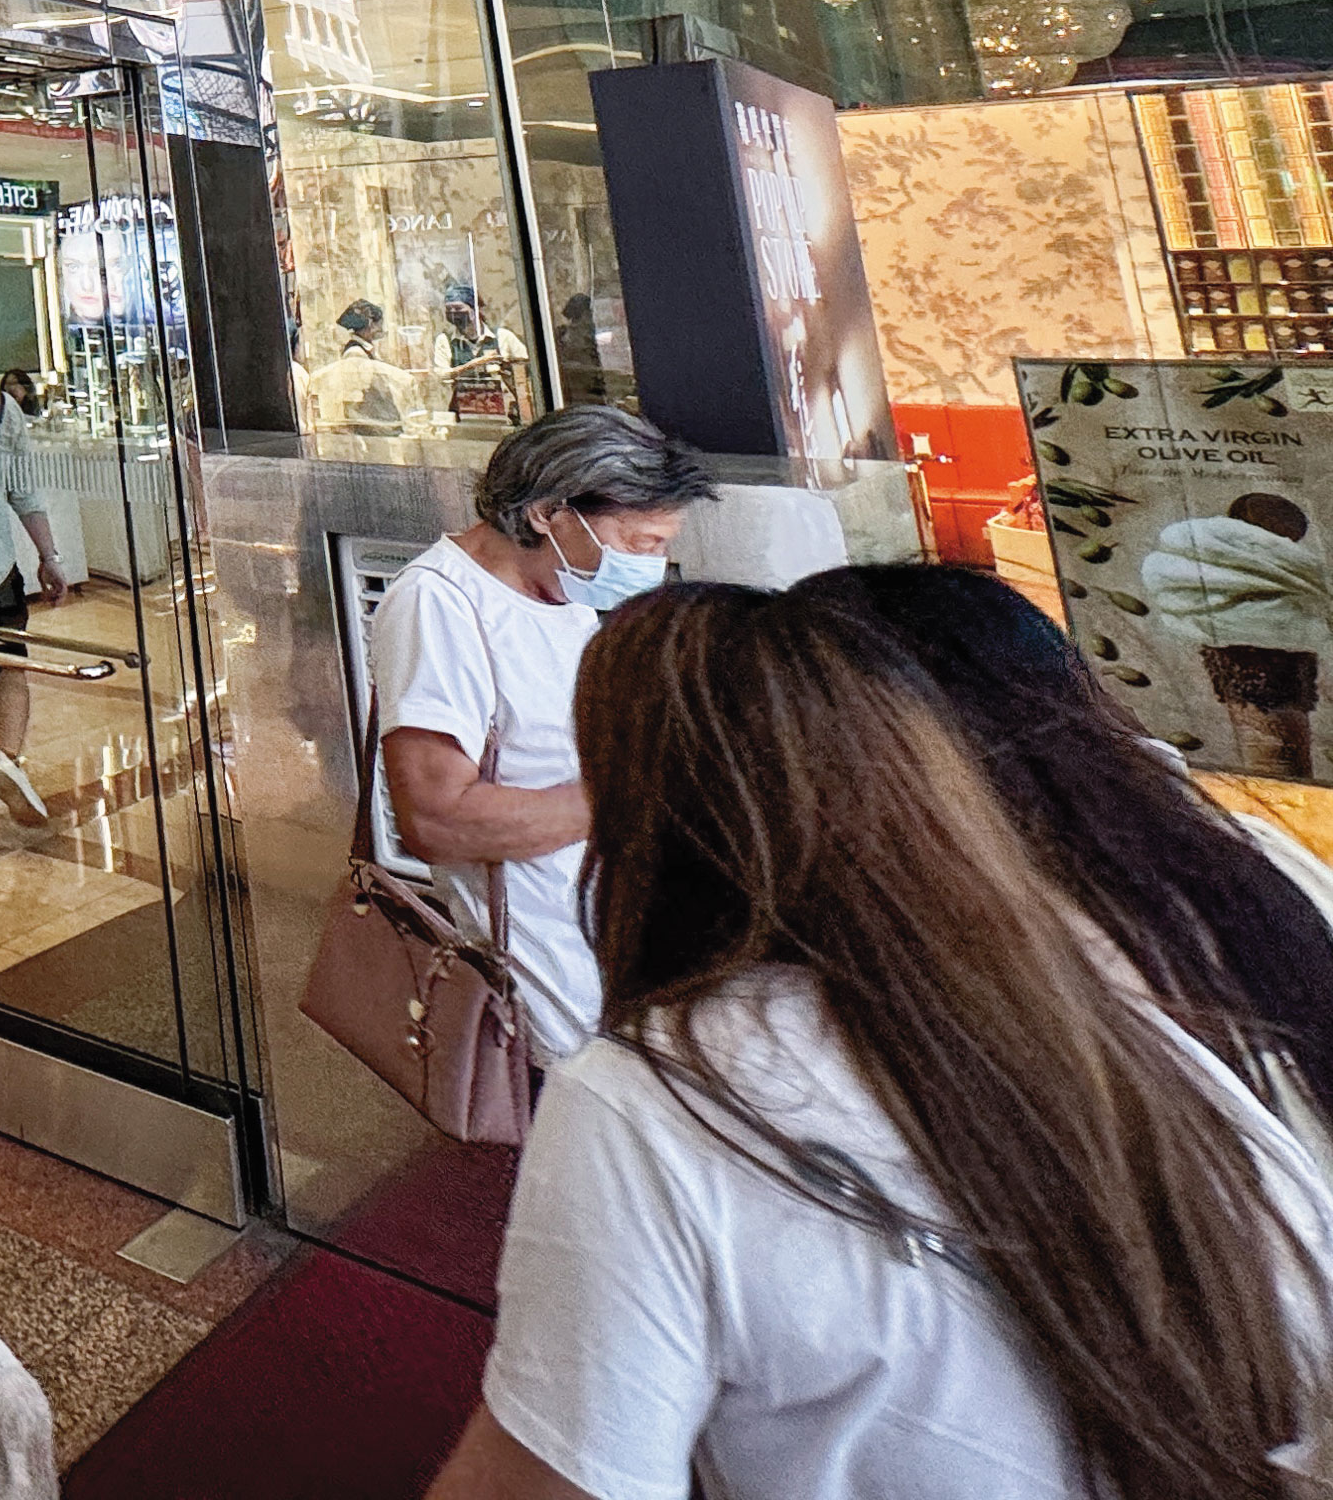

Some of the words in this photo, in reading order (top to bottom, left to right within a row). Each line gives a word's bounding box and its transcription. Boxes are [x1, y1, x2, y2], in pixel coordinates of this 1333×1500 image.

[1104, 425, 1197, 443] EXTRA
[1203, 428, 1304, 447] VIRGIN
[1137, 445, 1221, 463] OLIVE
[1226, 450, 1277, 465] OIL
